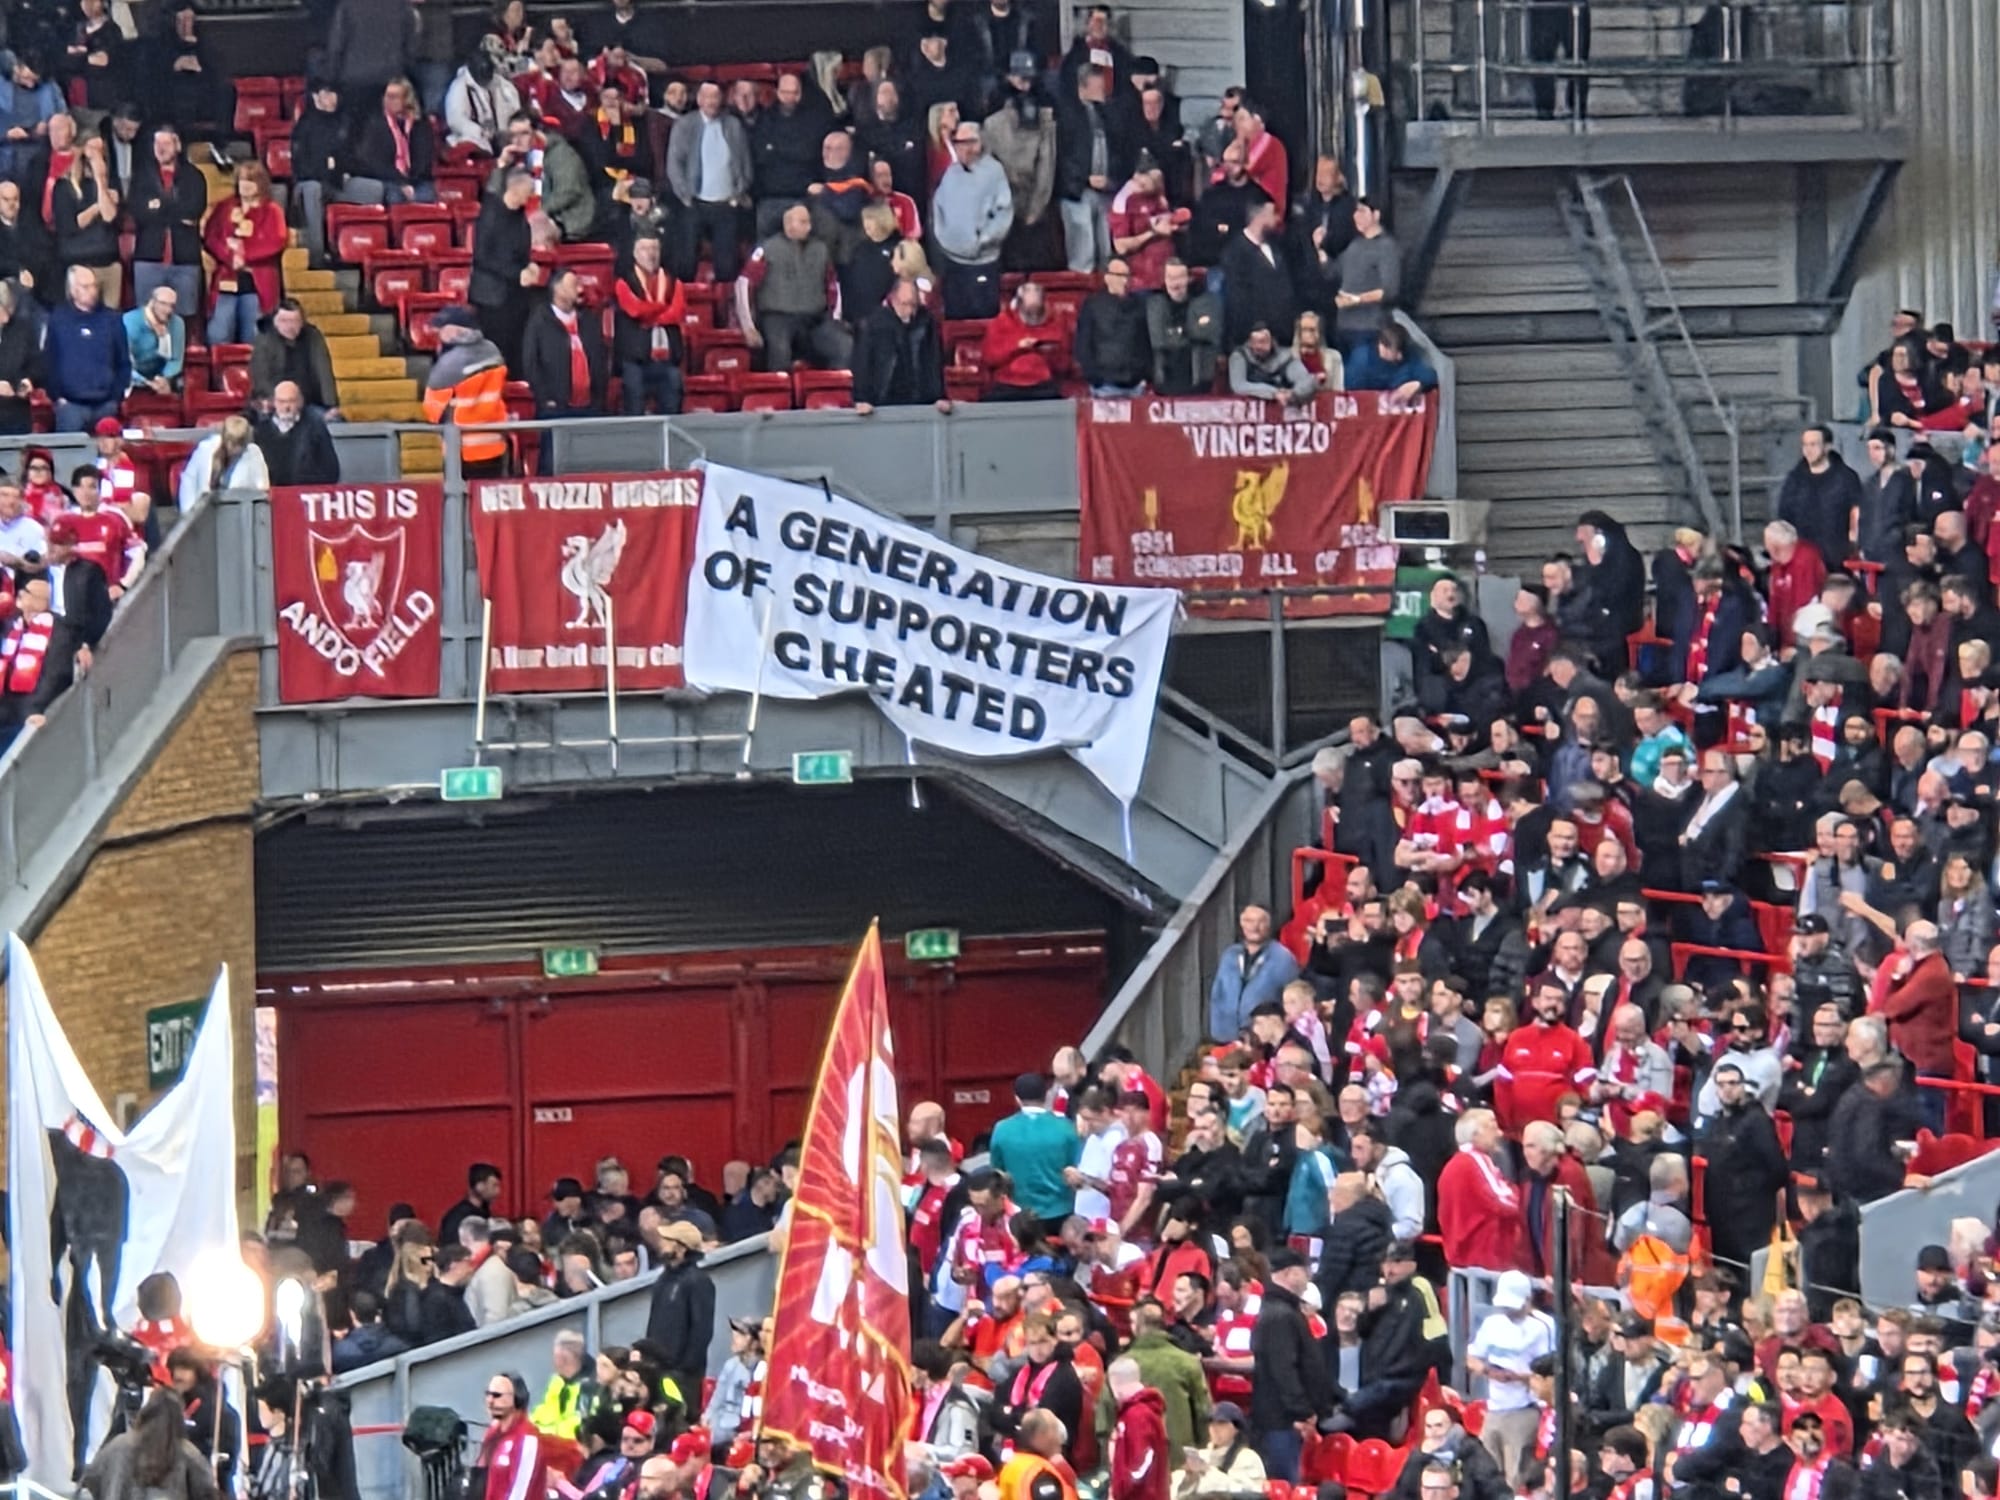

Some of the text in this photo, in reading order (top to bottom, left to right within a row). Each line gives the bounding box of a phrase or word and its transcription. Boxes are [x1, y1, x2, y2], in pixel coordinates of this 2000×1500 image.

[1182, 421, 1337, 457] 'VINCENZO'
[300, 488, 419, 522] THIS IS
[725, 494, 1128, 636] A GENERATION
[1260, 553, 1298, 576] ALL
[704, 550, 1136, 698] OF SUPPORTERS
[773, 630, 1047, 742] CHEATED
